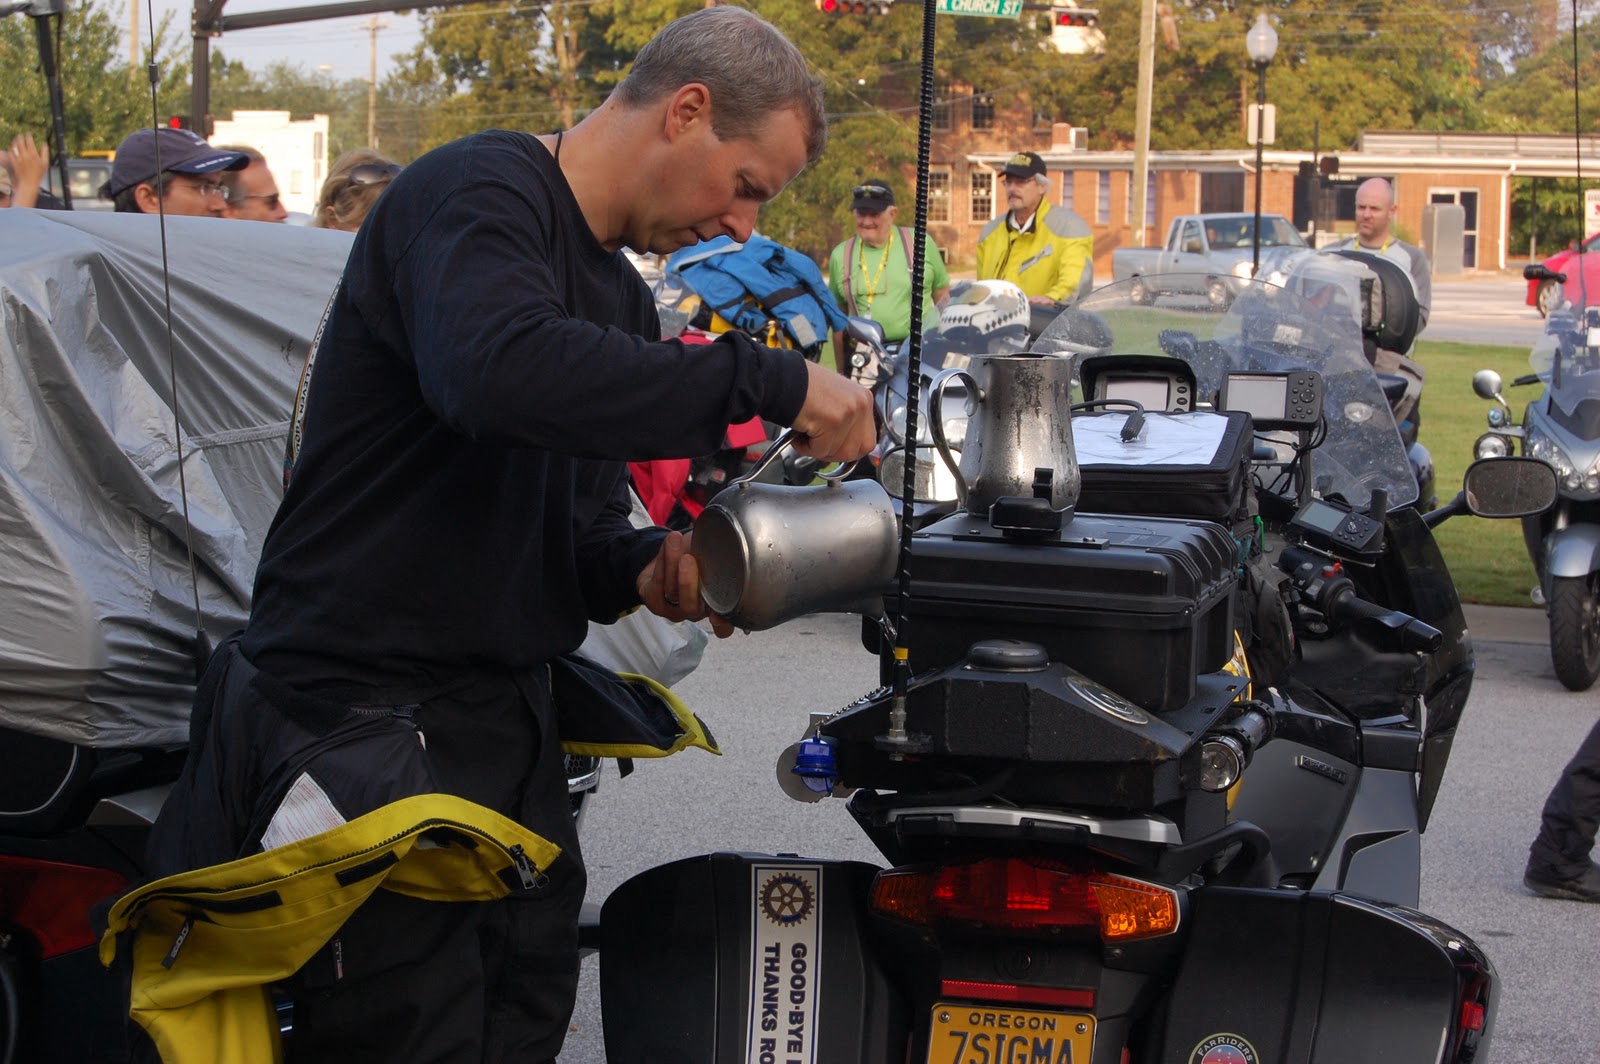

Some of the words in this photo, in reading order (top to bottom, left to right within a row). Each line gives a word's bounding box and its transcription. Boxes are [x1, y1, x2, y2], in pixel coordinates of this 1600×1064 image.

[951, 0, 999, 14] CHURCH
[761, 942, 781, 1032] THANKS
[786, 942, 807, 1053] GOOD-BYE
[968, 1011, 1057, 1031] OREGON
[759, 1037, 776, 1064] RO
[949, 1030, 1074, 1064] 7SIGMA
[1197, 1036, 1253, 1061] FARRIDERS
